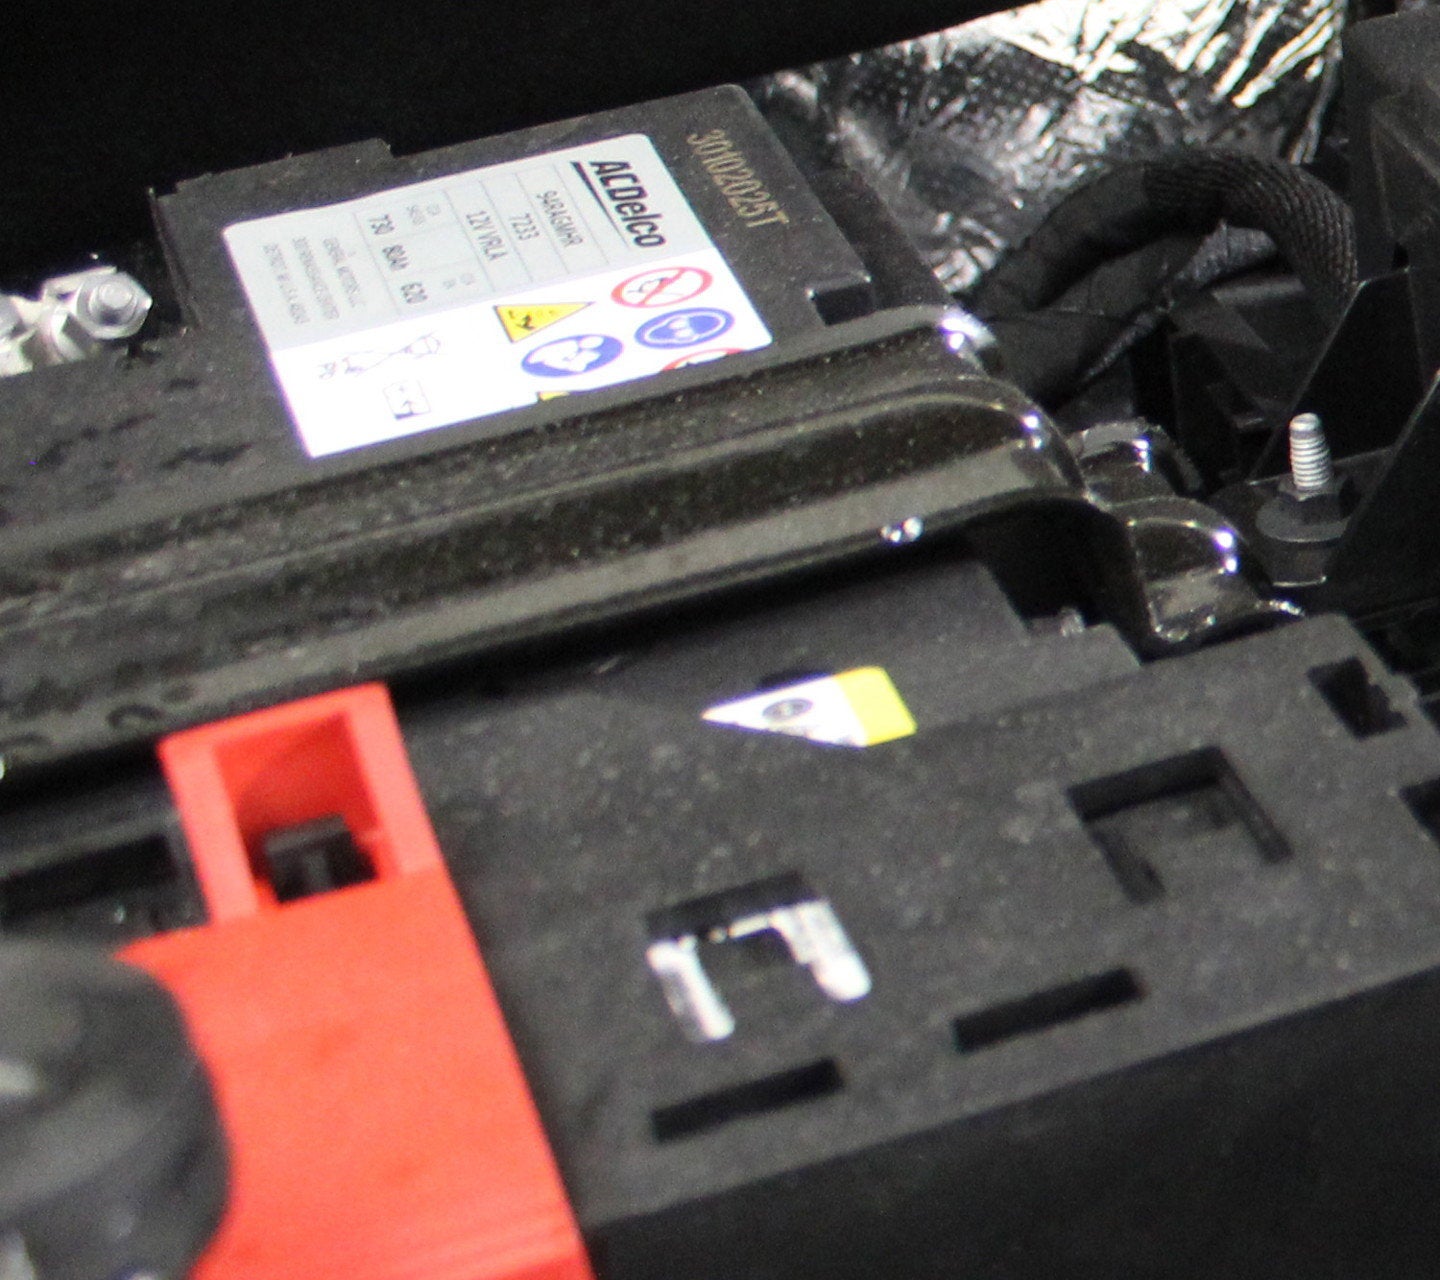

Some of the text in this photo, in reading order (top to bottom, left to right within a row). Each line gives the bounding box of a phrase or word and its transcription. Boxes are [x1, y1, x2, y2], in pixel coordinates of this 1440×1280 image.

[508, 213, 540, 241] 7233
[590, 160, 665, 248] ACDelco
[466, 211, 508, 261] 12V VRLA
